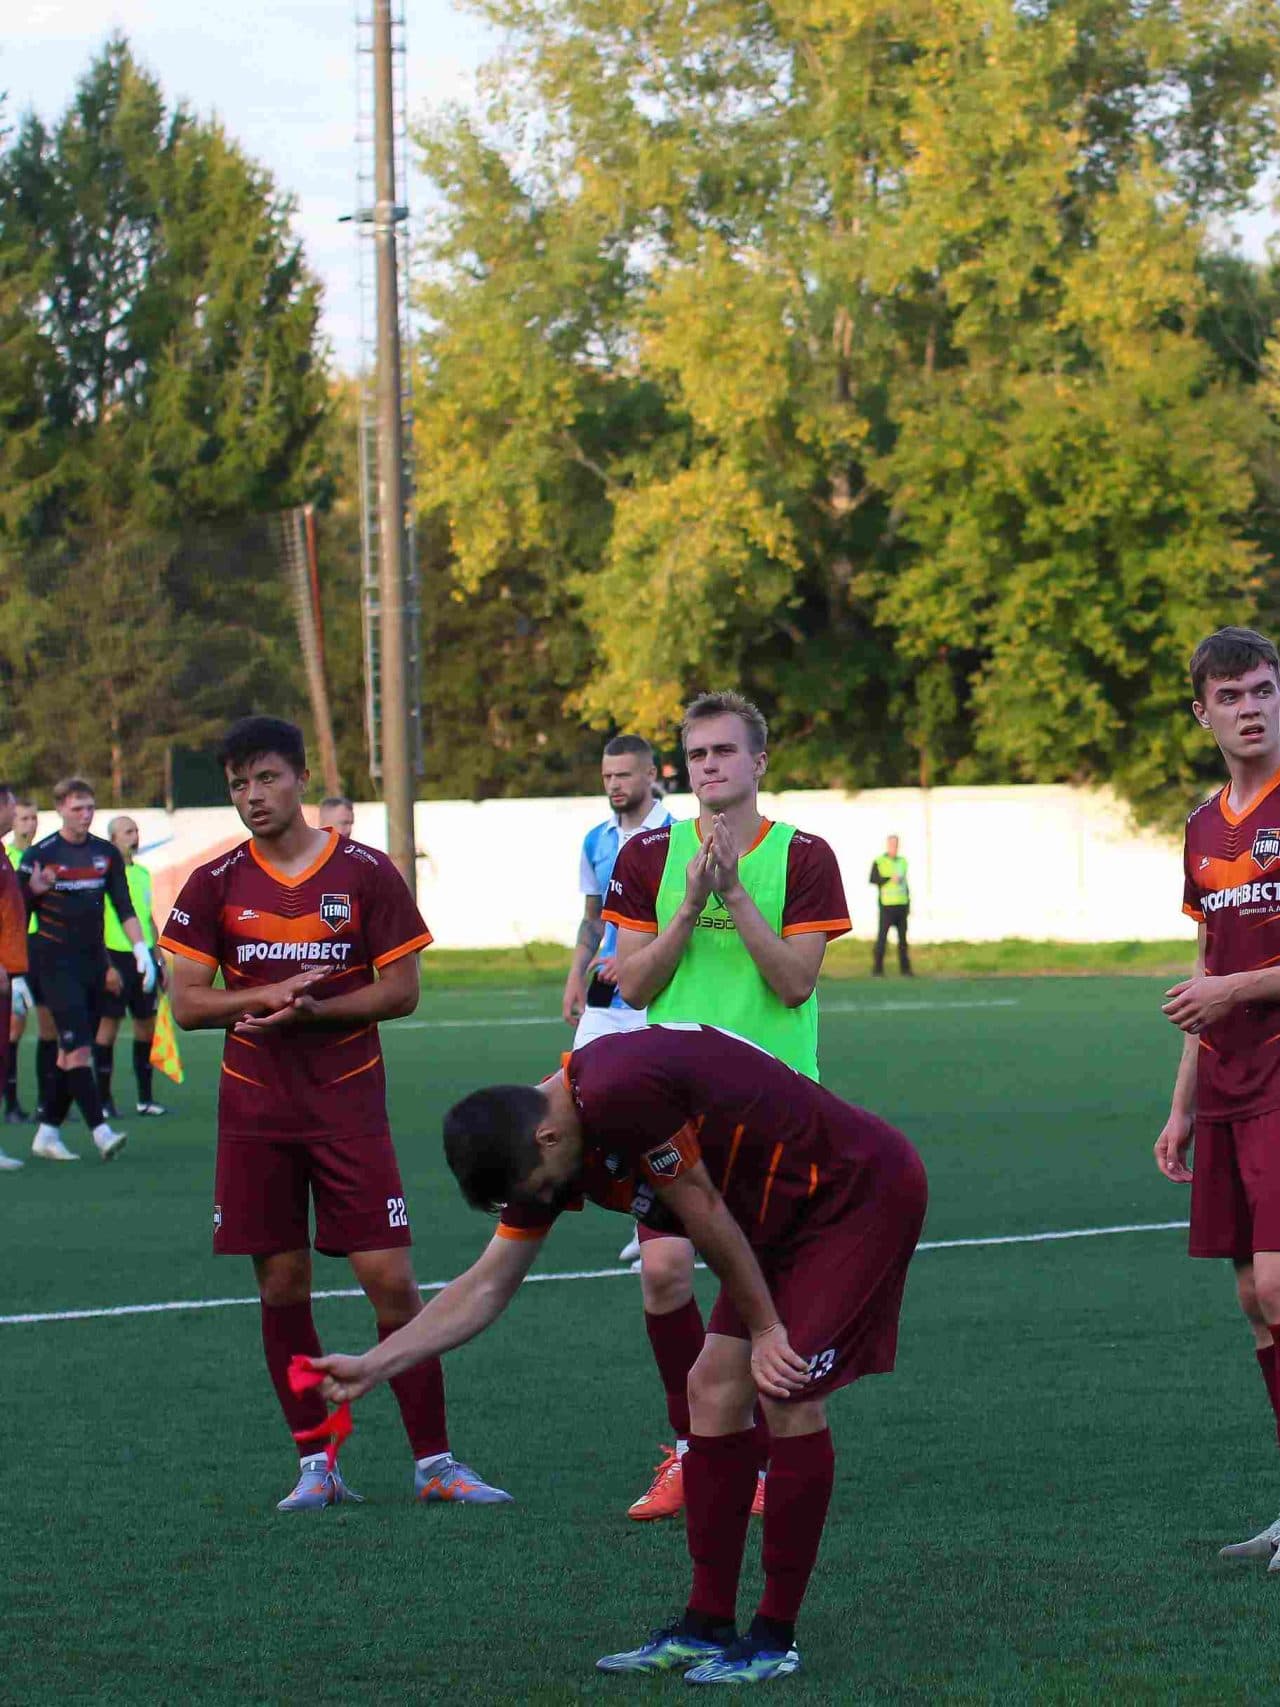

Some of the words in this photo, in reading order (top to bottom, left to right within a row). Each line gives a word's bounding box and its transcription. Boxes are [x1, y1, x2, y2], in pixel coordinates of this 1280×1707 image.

[1255, 841, 1279, 854] ТЕМП
[323, 904, 348, 918] ТЕМП
[236, 942, 351, 965] ПРОДИНВЕСТ
[652, 1151, 679, 1172] ТЕМП
[387, 1197, 408, 1228] 22
